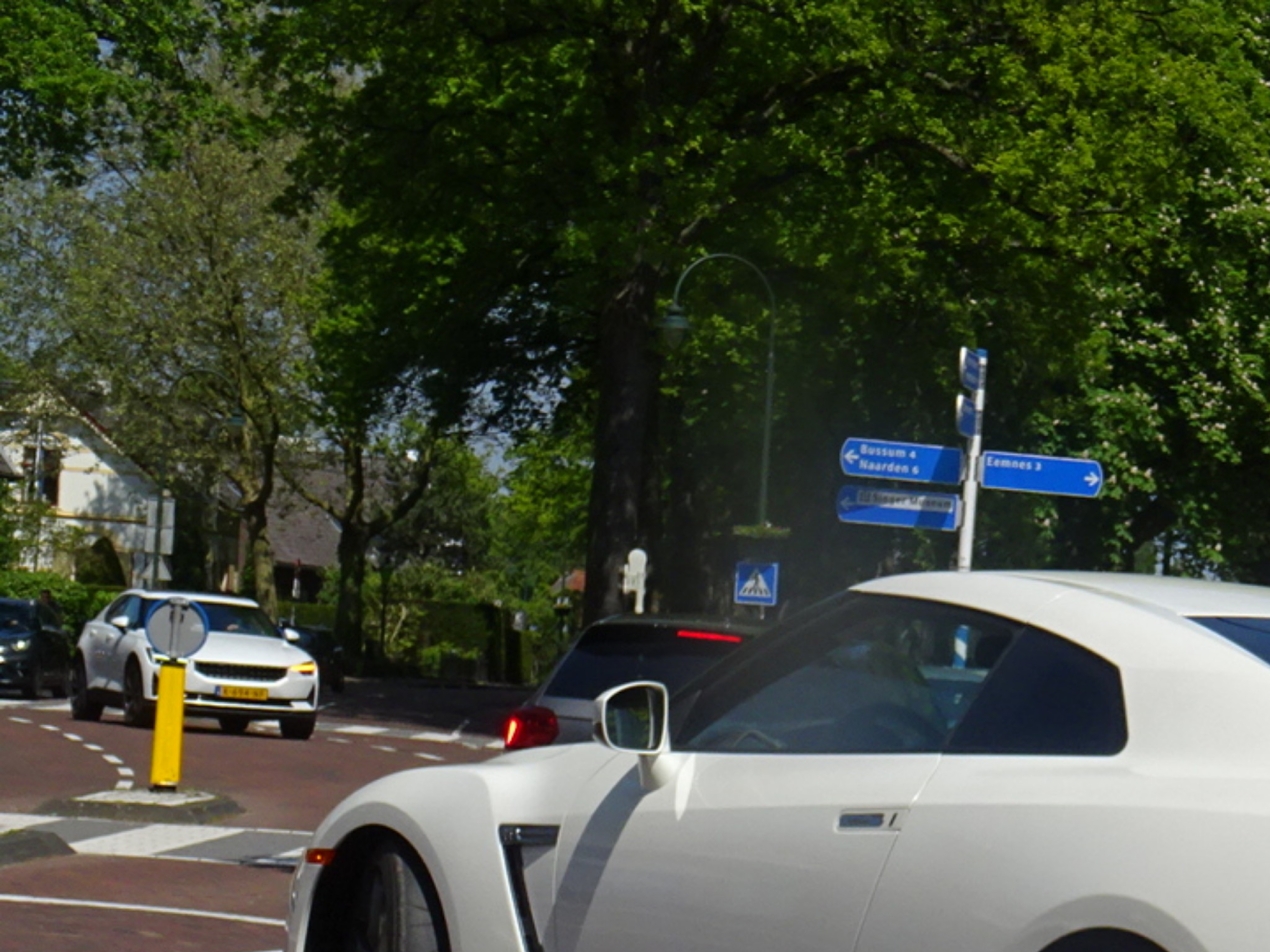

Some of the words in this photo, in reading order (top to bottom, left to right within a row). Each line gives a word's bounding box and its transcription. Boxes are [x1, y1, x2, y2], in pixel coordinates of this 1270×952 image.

[860, 444, 906, 458] Bussum
[909, 451, 917, 459] 4
[859, 460, 909, 474] Naarden
[911, 466, 920, 475] 6
[987, 457, 1032, 470] Eemnes
